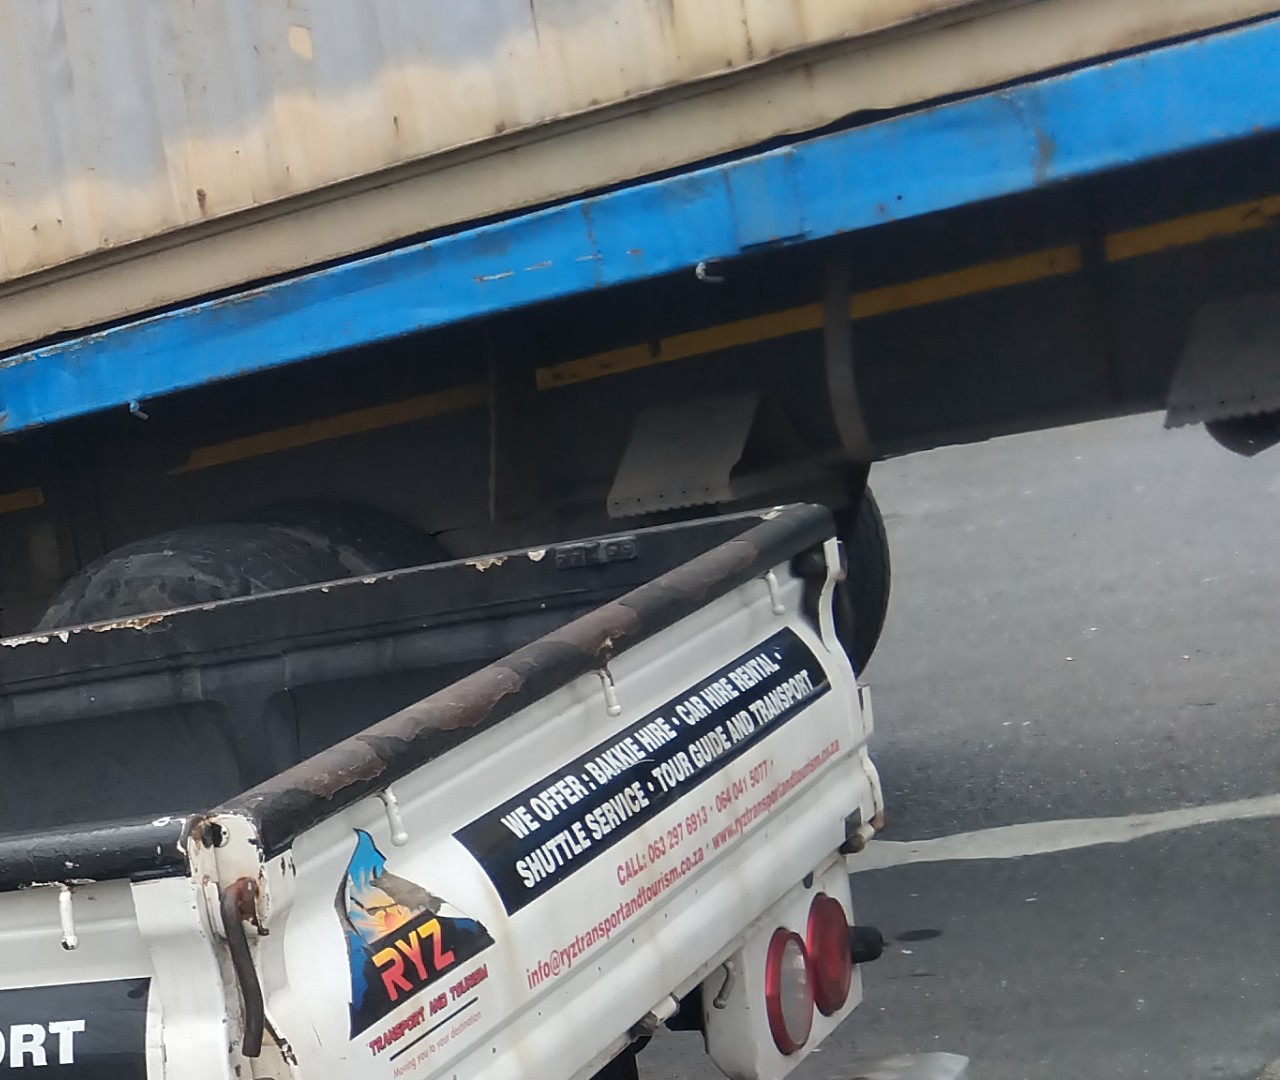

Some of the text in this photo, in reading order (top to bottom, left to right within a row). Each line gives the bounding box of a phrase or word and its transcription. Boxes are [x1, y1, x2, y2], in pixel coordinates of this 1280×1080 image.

[500, 653, 780, 840] WE OFFER BAKKIE HIRE CAR HIRE RENTAL
[515, 669, 814, 889] SHUTTLE SERVICE TOUR GUIDE AND TRANSPORT
[617, 759, 769, 886] CALL: 063 297 6913 064 041 5077
[371, 918, 456, 1002] RYZ
[526, 847, 705, 990] info@ryztransportandtourism.co.za
[369, 963, 489, 1057] TRANSPORT AND TOURISM
